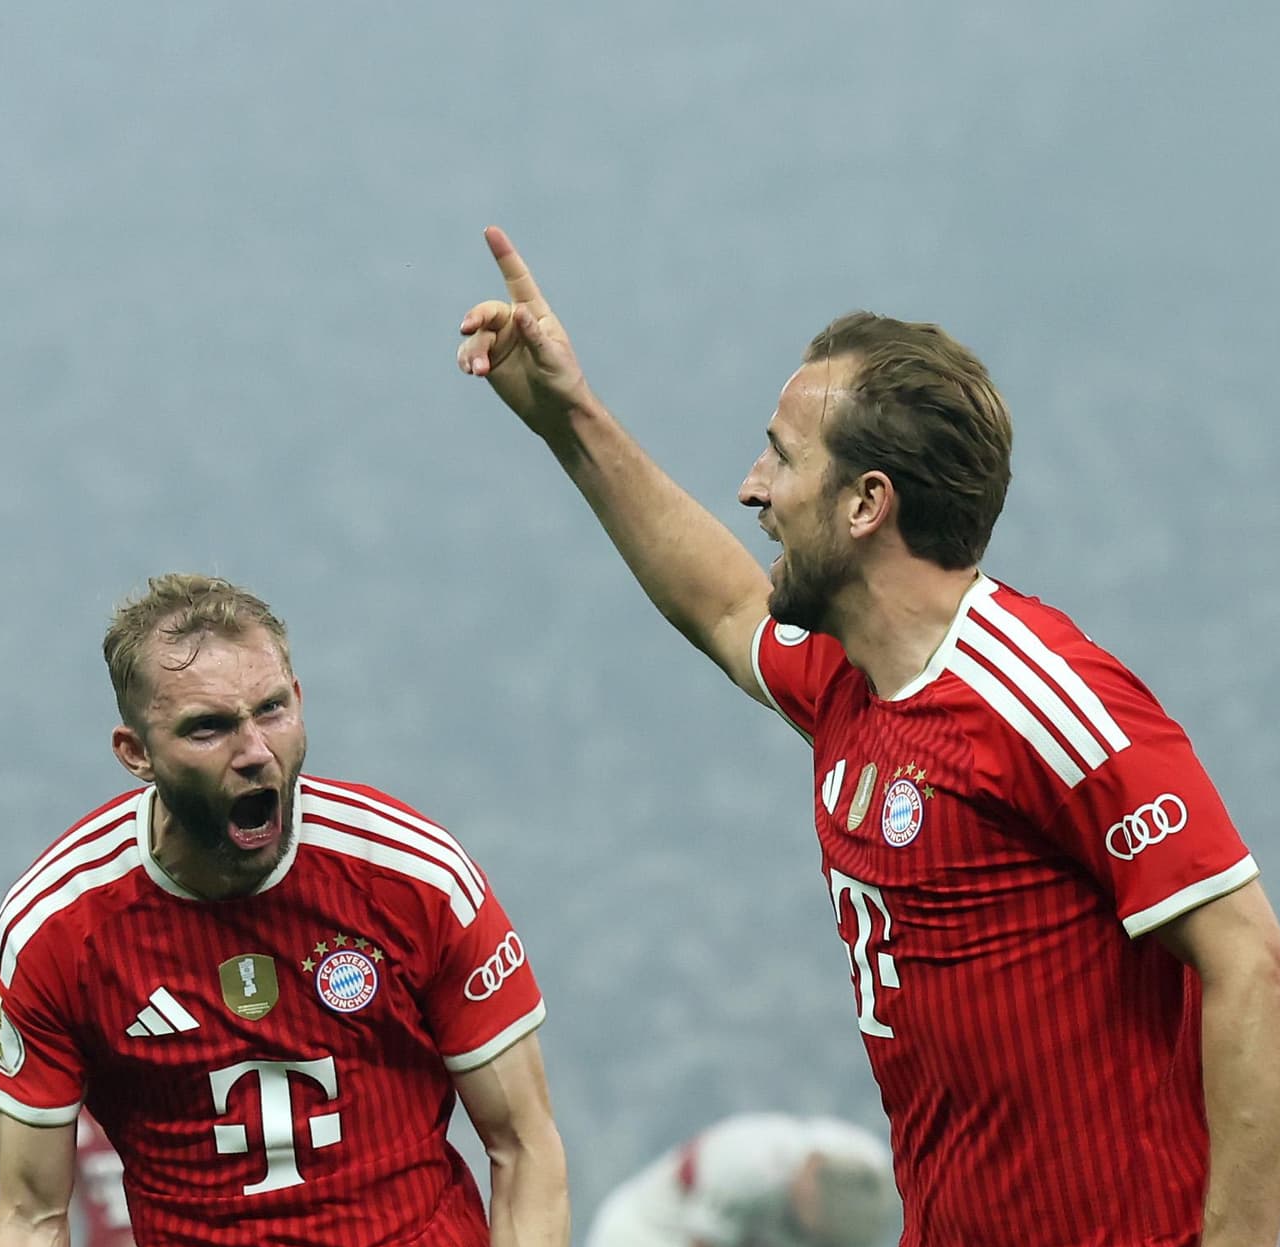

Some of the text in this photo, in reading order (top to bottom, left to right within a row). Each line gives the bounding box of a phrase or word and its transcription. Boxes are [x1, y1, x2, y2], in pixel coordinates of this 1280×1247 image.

[321, 955, 371, 980] FC BAYERN
[209, 1055, 342, 1196] T
